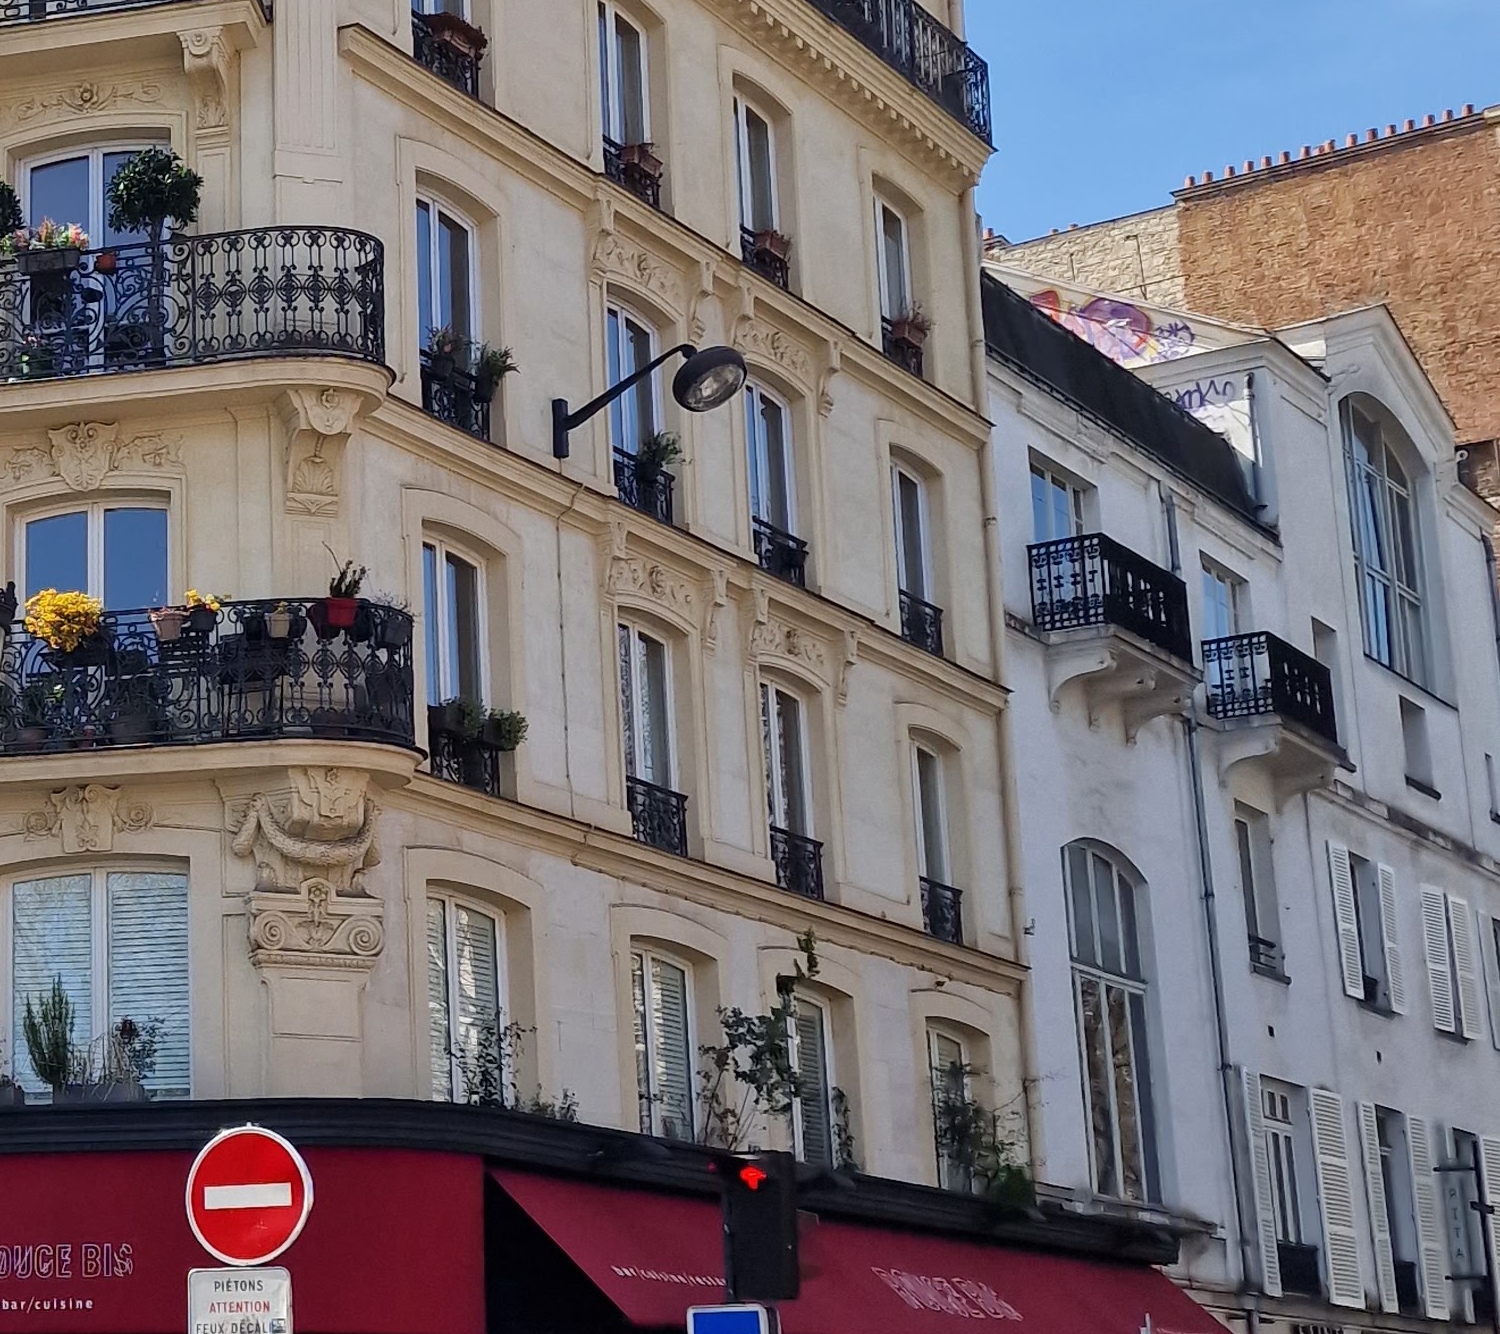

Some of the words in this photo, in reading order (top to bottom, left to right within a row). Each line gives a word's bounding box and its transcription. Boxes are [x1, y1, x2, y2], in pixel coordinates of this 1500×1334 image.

[81, 1243, 134, 1278] BIS
[214, 1278, 264, 1293] PIÉTONS
[1, 1297, 94, 1314] bar/cuisine
[209, 1301, 270, 1314] ATTENTION
[196, 1323, 225, 1334] FEUX
[231, 1319, 272, 1334] DÉCAL
